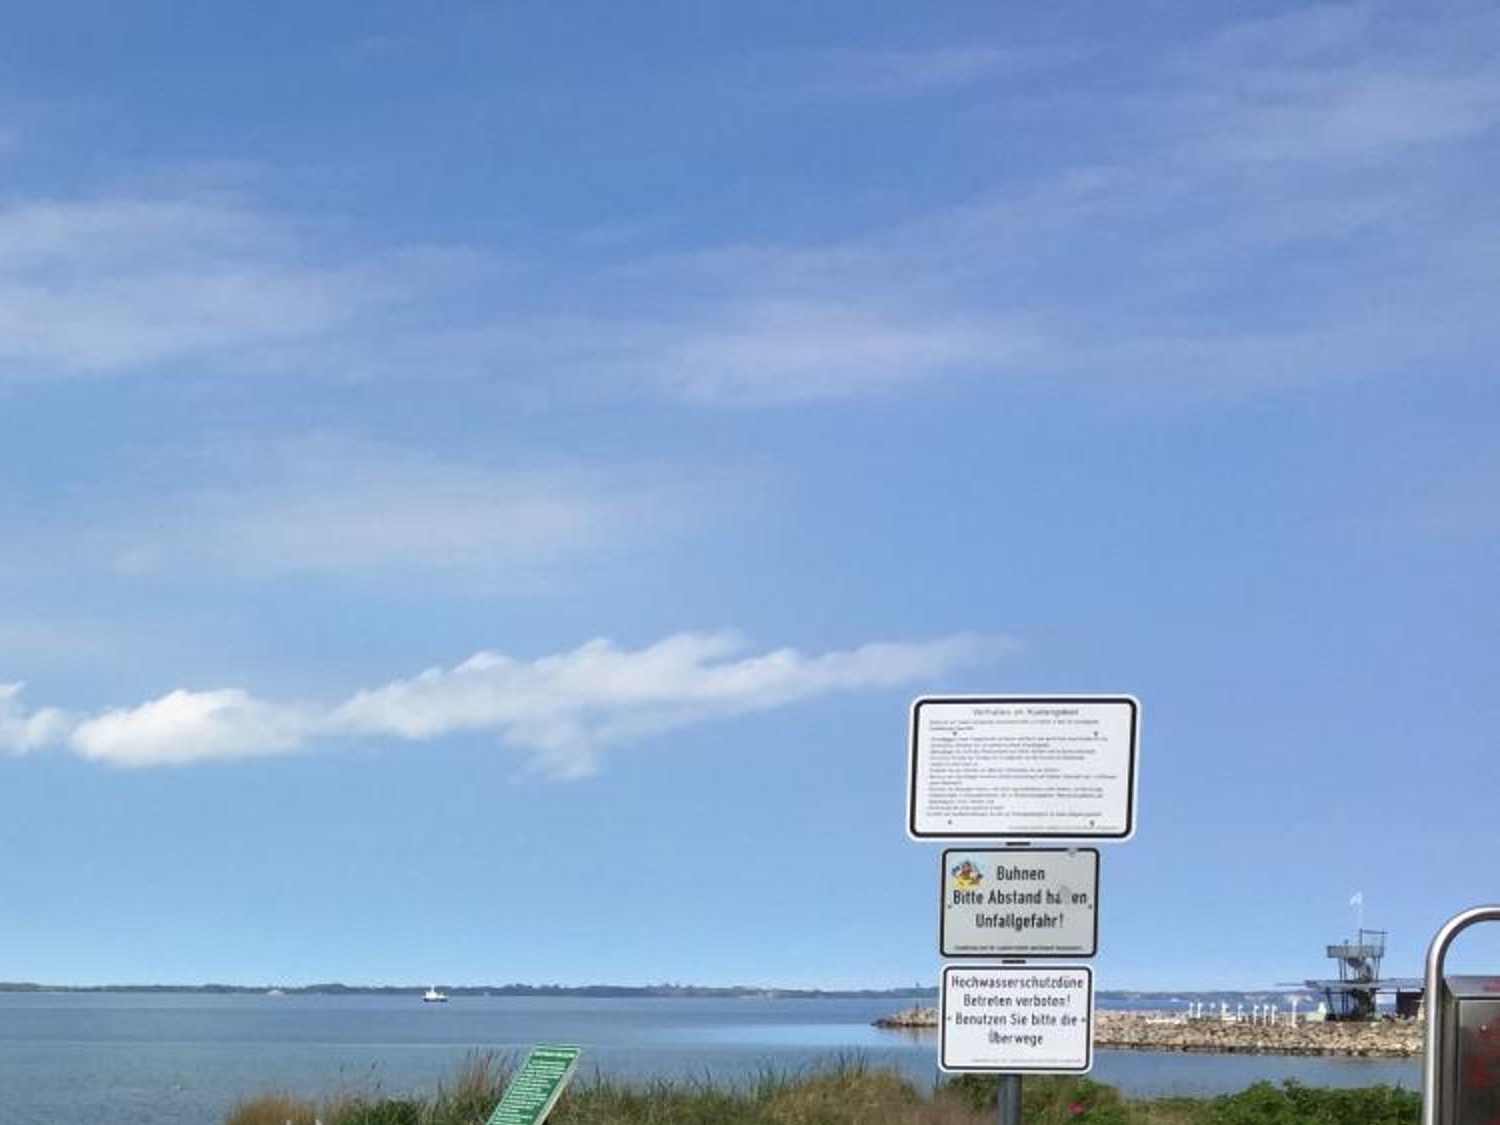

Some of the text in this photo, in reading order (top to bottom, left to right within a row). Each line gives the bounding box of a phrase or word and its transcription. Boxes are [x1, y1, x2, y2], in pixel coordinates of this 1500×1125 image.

[996, 865, 1045, 881] Buhnen
[953, 889, 1087, 905] Bitte Abstand haen
[975, 914, 1064, 932] Unfallgefahr!
[951, 975, 1084, 989] Hochwasserschutzdüne
[963, 994, 1071, 1007] Betreten verboten!
[955, 1012, 1077, 1026] Benutzen Sie bitte die
[987, 1029, 1043, 1047] Überwege
